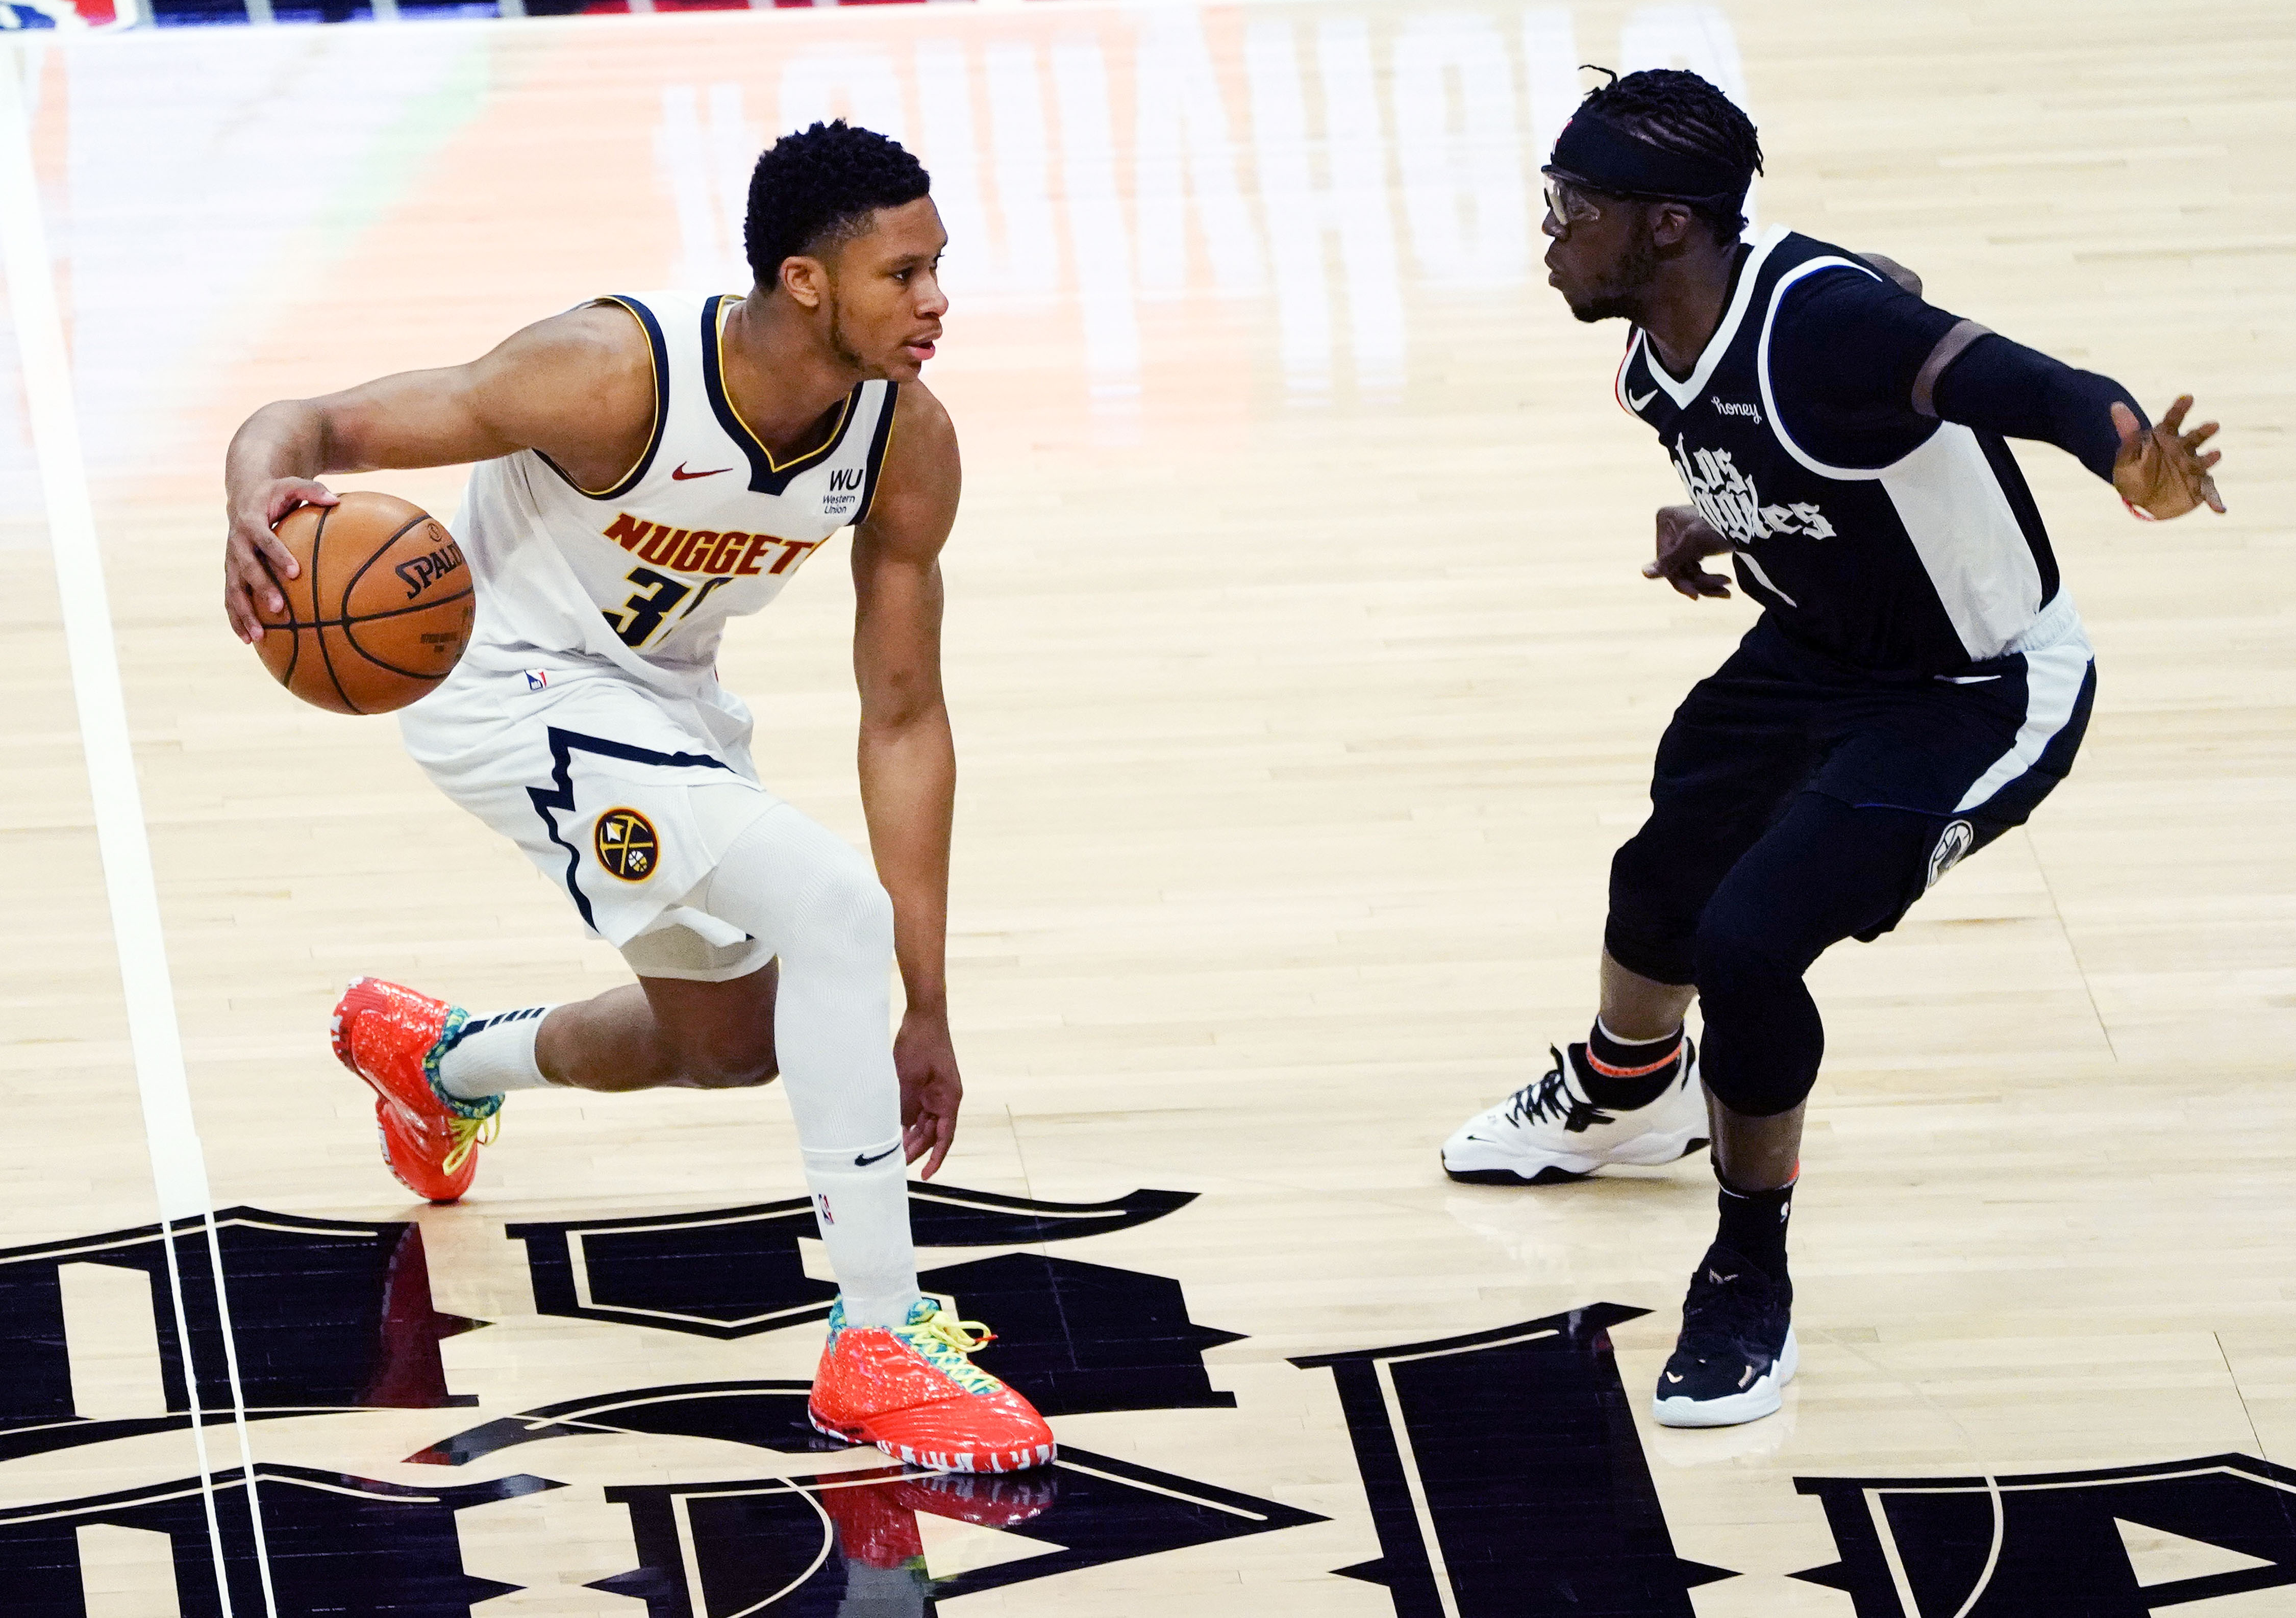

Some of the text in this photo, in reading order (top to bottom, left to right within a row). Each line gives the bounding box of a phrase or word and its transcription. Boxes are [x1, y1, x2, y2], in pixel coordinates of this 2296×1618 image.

[1711, 396, 1762, 425] honey
[830, 469, 863, 491] WU
[1675, 432, 1749, 496] Los
[823, 495, 855, 504] Western
[825, 505, 846, 514] Union
[1693, 474, 1837, 544] ngeles
[603, 512, 833, 575] NUGGET
[602, 567, 735, 650] 3
